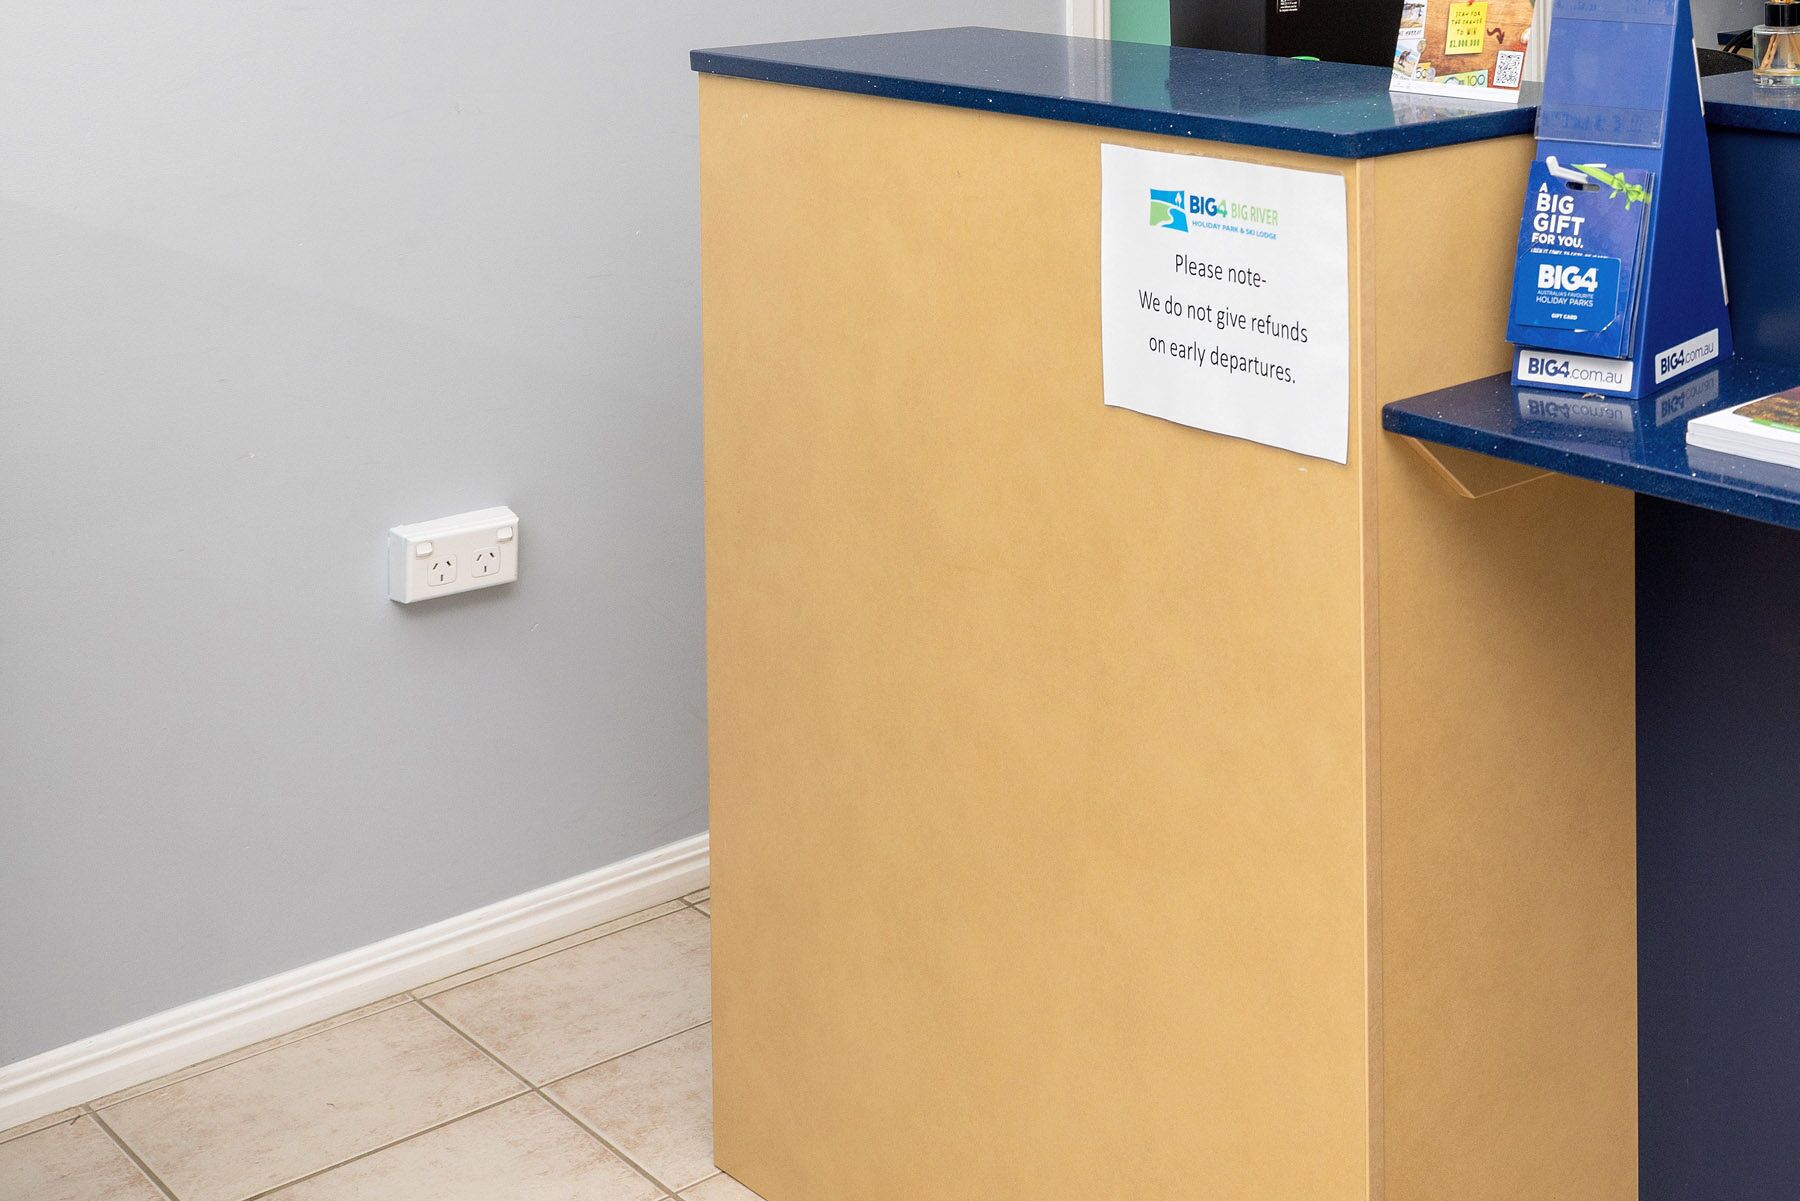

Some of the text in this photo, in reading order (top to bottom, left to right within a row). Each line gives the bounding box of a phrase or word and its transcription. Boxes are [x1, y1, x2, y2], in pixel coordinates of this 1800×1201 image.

[1539, 182, 1549, 193] A
[1190, 195, 1279, 226] BIG4 BIG RIVER
[1536, 193, 1575, 215] BIG
[1192, 220, 1221, 230] HOLIDAY
[1222, 224, 1239, 234] PARK
[1256, 231, 1277, 240] LODGE
[1533, 214, 1585, 236] GIFT
[1531, 233, 1584, 249] FOR YOU.
[1175, 254, 1267, 288] Please note-
[1538, 264, 1598, 292] BIG4
[1536, 296, 1594, 307] HOLIDAY PARKS
[1138, 289, 1308, 344] We do not give refunds
[1149, 336, 1296, 384] on early departures.
[1527, 358, 1623, 385] BIG4.com.au
[1661, 342, 1714, 375] BIG4.com.au
